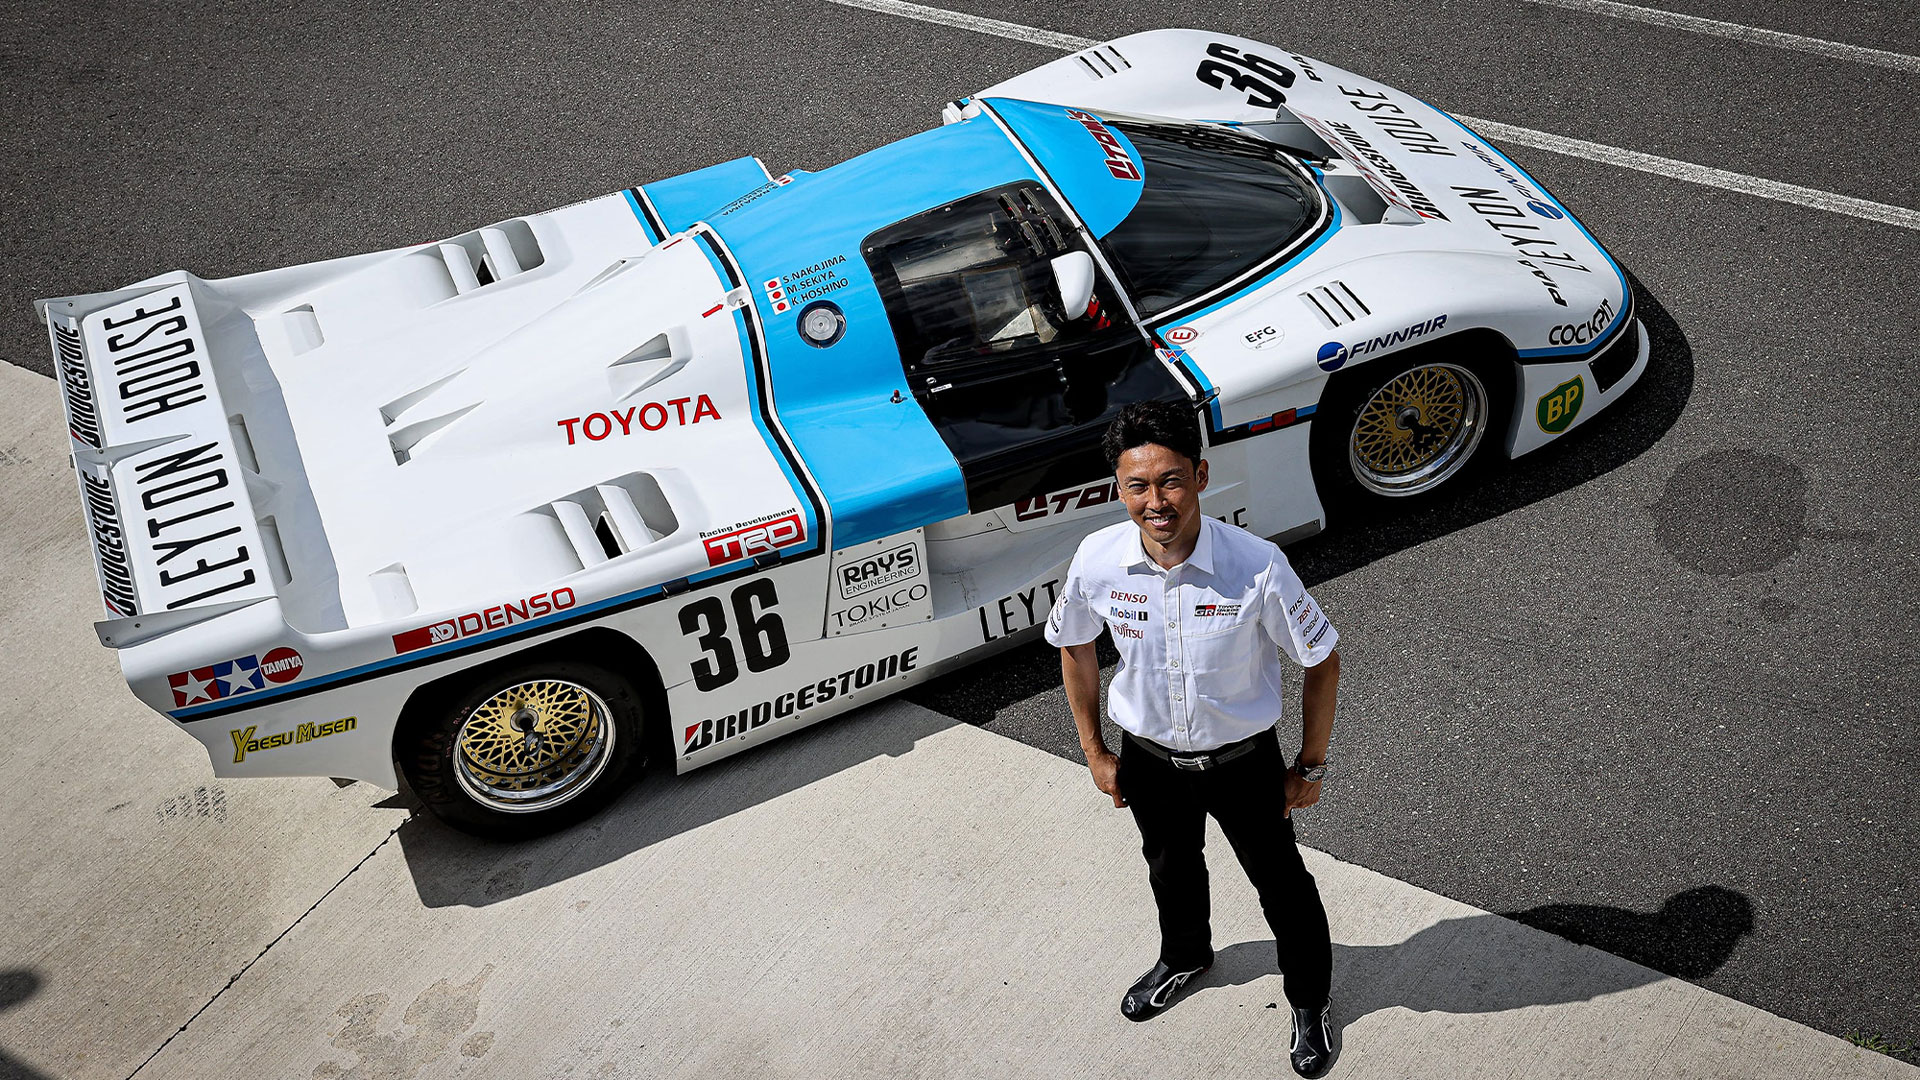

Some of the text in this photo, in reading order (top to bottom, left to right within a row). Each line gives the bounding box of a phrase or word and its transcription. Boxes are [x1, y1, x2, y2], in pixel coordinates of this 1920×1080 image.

[1196, 43, 1296, 109] 36
[1290, 53, 1323, 82] PIA
[1325, 119, 1451, 223] BRIDGESTONE
[1338, 84, 1592, 273] LEYTON HOUSE
[782, 254, 847, 284] S.NAKAJIMA
[787, 270, 836, 295] M.SEKIYA
[1517, 260, 1568, 307] PIAA
[791, 277, 849, 306] K.HOSHINO
[1245, 325, 1277, 343] EFG
[1349, 313, 1448, 360] FINNAIR
[1549, 298, 1615, 345] COCKPIT
[53, 319, 102, 449] BRIDGESTONE
[1546, 384, 1580, 426] BP
[557, 393, 722, 445] TOYOTA
[103, 295, 256, 610] LEYTON HOUSE
[82, 471, 137, 617] BRIDGESTONE
[699, 507, 797, 539] Racing Development
[709, 519, 798, 559] TRD
[843, 547, 914, 586] RAYS
[846, 566, 915, 595] ENGINEERING
[460, 587, 577, 637] DENSO
[831, 584, 927, 627] TOKICO
[1109, 606, 1137, 621] Mobil
[1110, 590, 1148, 604] DENSO
[1195, 607, 1216, 616] GR
[678, 577, 791, 692] 36
[1113, 623, 1144, 639] FUJITSU
[260, 654, 304, 676] TAMIYA
[683, 646, 919, 756] BRIDGESTONE
